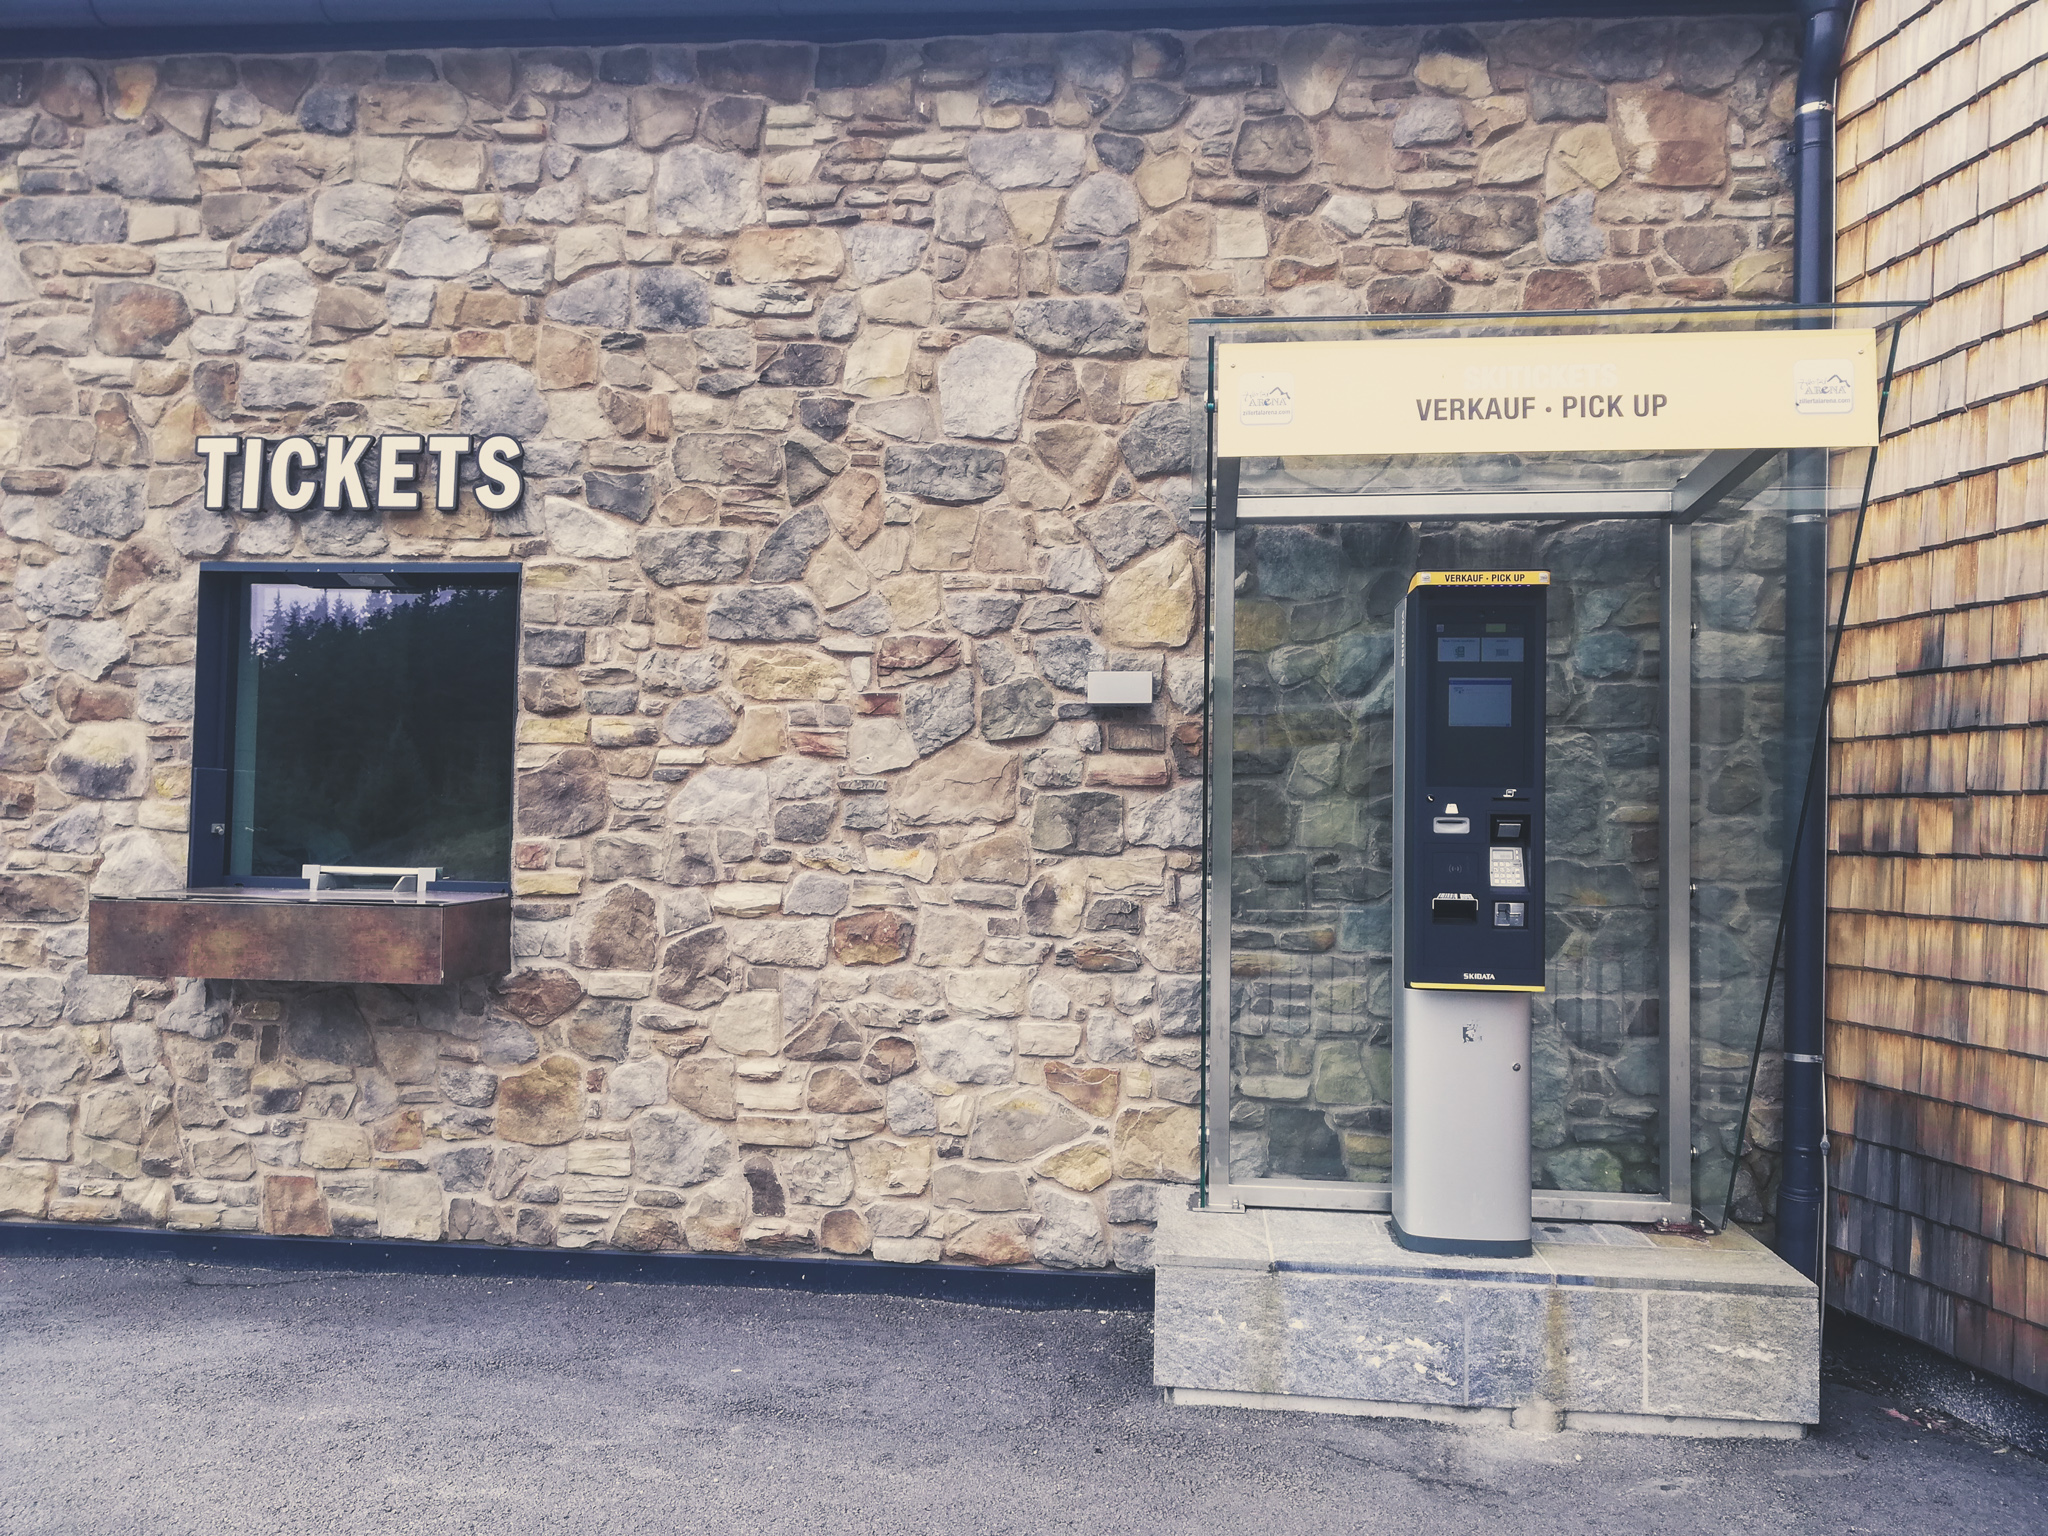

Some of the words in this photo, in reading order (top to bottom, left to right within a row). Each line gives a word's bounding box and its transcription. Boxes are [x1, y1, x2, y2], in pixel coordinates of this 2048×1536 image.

[1416, 396, 1536, 421] VERKAUF
[1562, 395, 1625, 418] PICK
[1633, 394, 1668, 417] UP
[195, 434, 525, 513] TICKETS
[1445, 574, 1484, 582] VERKAUF
[1491, 573, 1512, 582] PICK
[1513, 573, 1526, 582] UP
[1463, 972, 1496, 981] SKIDATA
